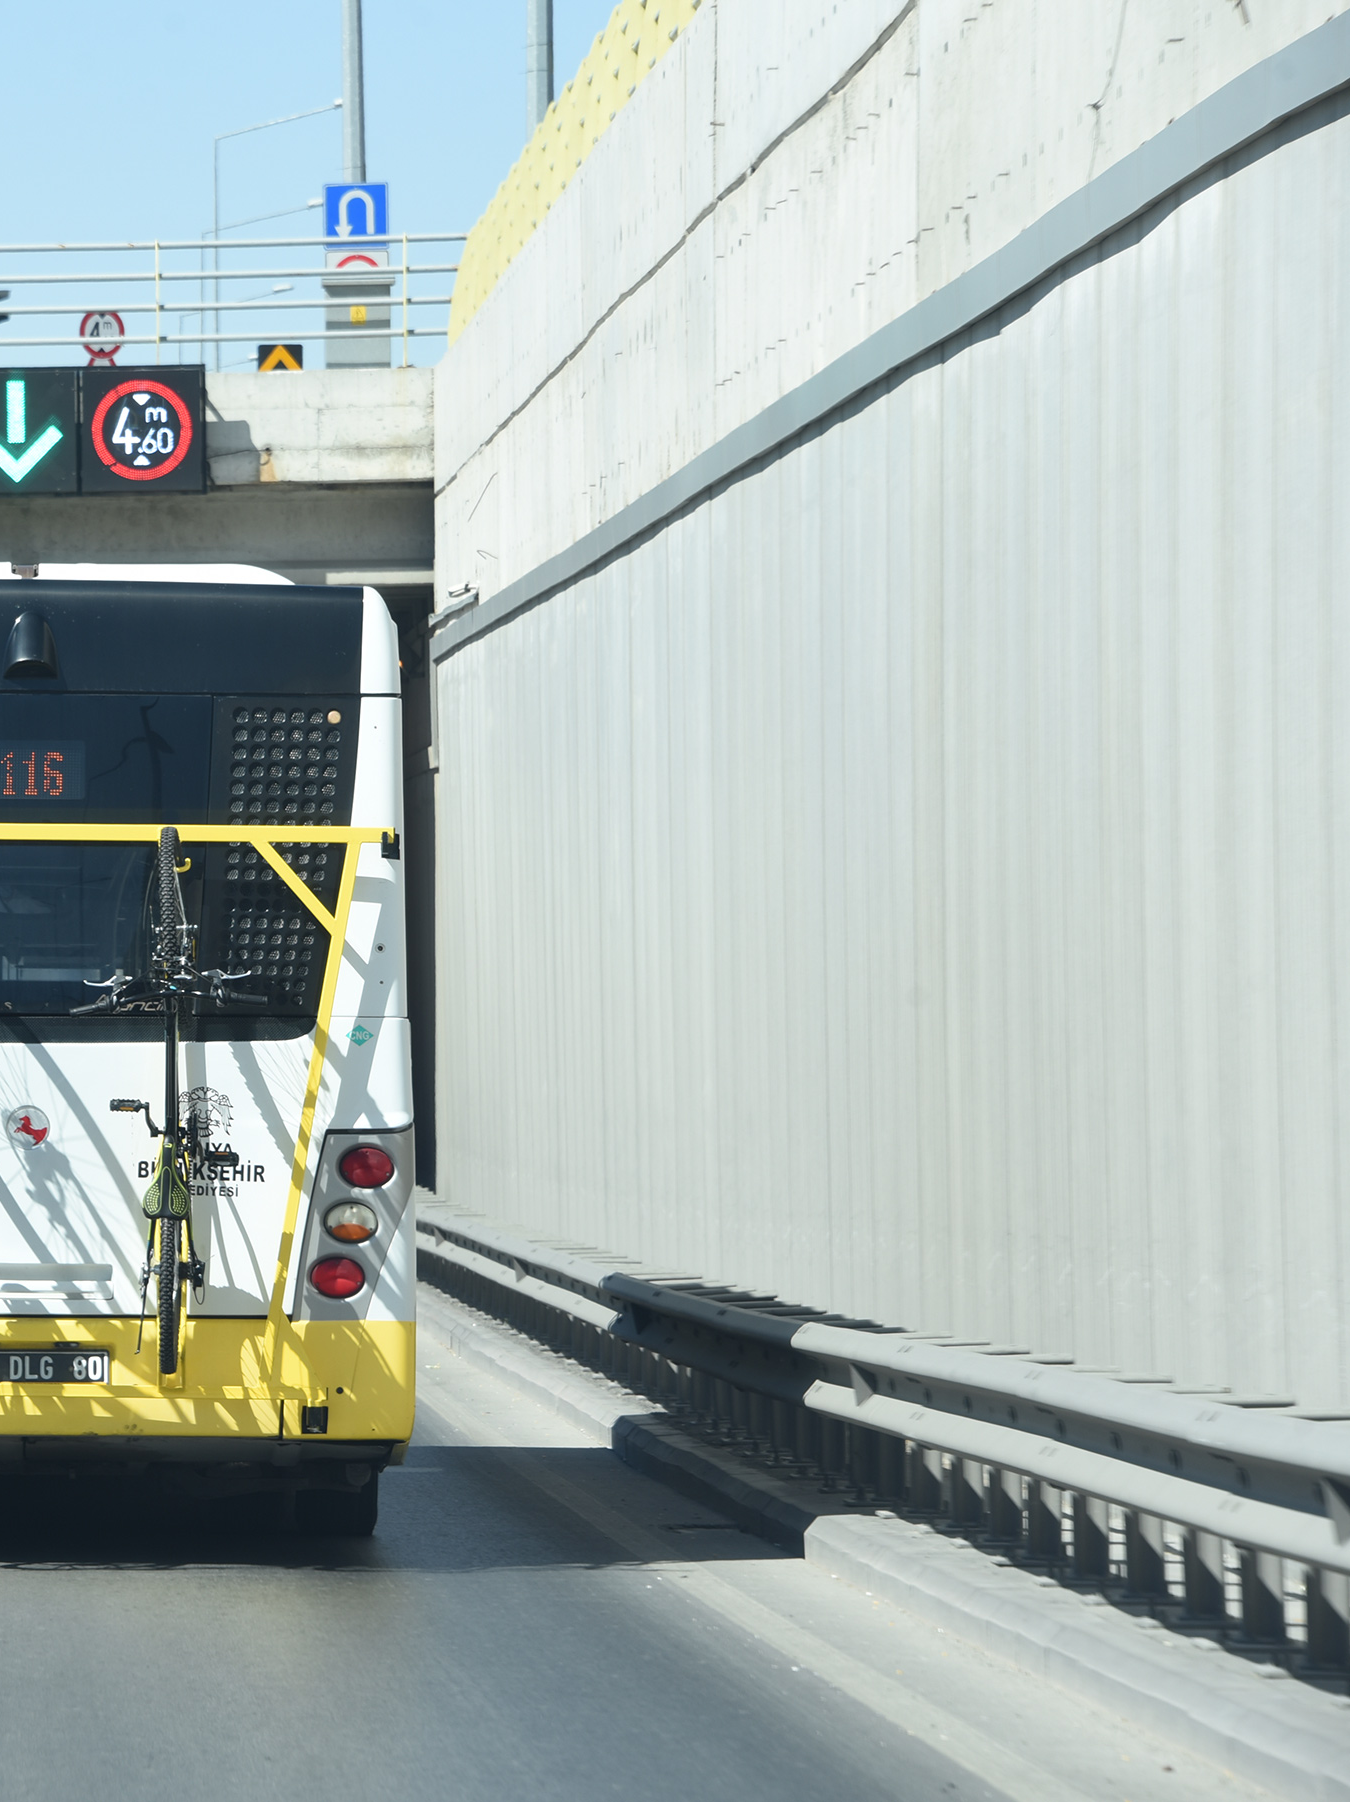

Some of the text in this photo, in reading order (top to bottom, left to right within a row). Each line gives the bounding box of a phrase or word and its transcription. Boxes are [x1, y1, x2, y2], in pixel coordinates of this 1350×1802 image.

[145, 406, 168, 423] m
[0, 751, 64, 795] 116
[348, 1031, 370, 1041] CNG
[9, 1356, 53, 1380] DLG
[73, 1355, 102, 1380] 80
